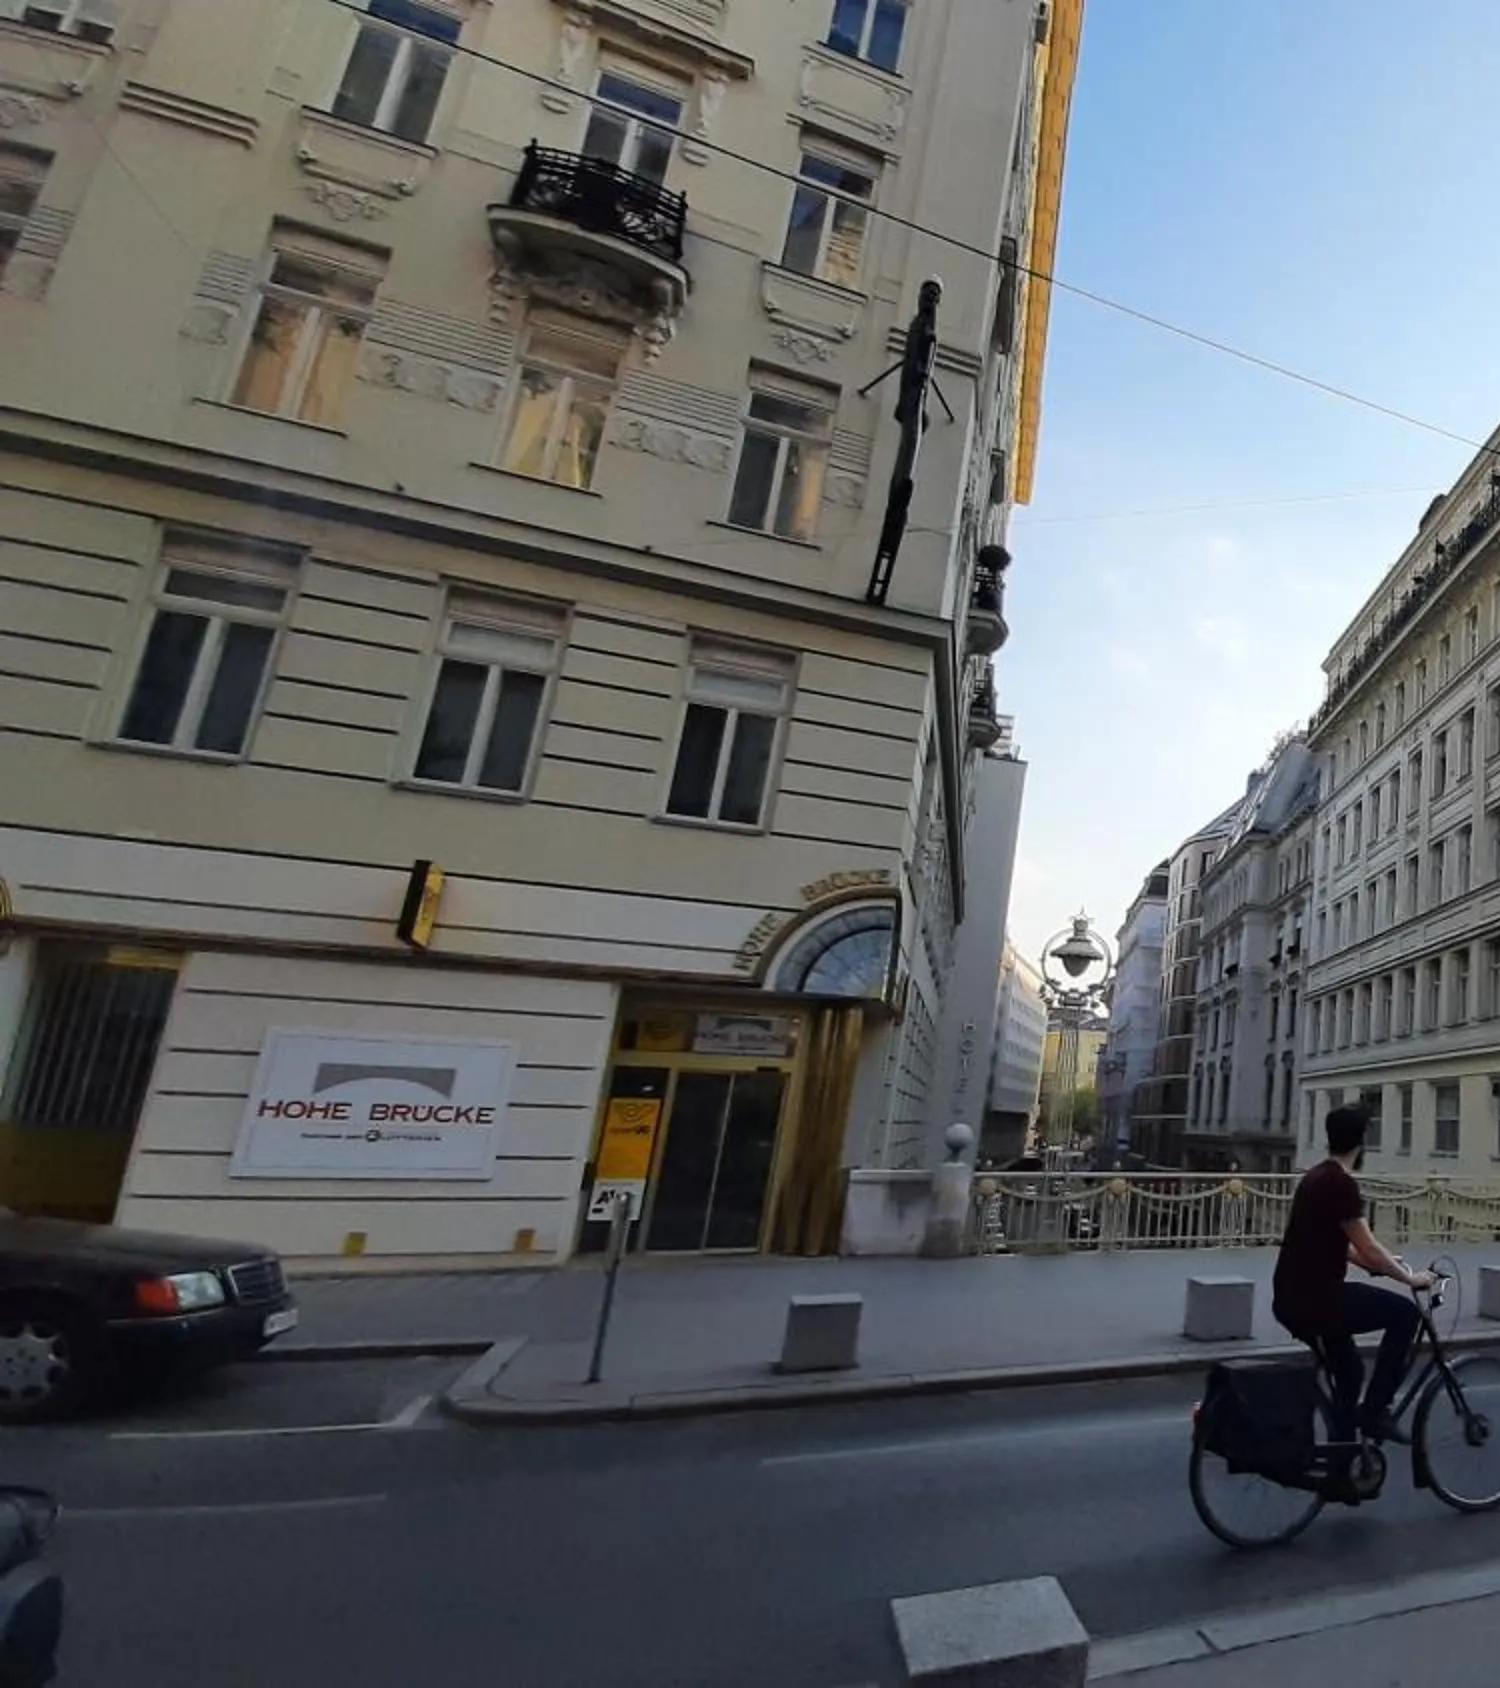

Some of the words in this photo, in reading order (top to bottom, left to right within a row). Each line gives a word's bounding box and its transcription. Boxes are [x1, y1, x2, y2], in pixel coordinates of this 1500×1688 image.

[732, 912, 779, 971] HOHE
[801, 869, 890, 899] BRÜCKE
[257, 1100, 352, 1121] HOHE
[369, 1103, 496, 1125] BRÜCKE
